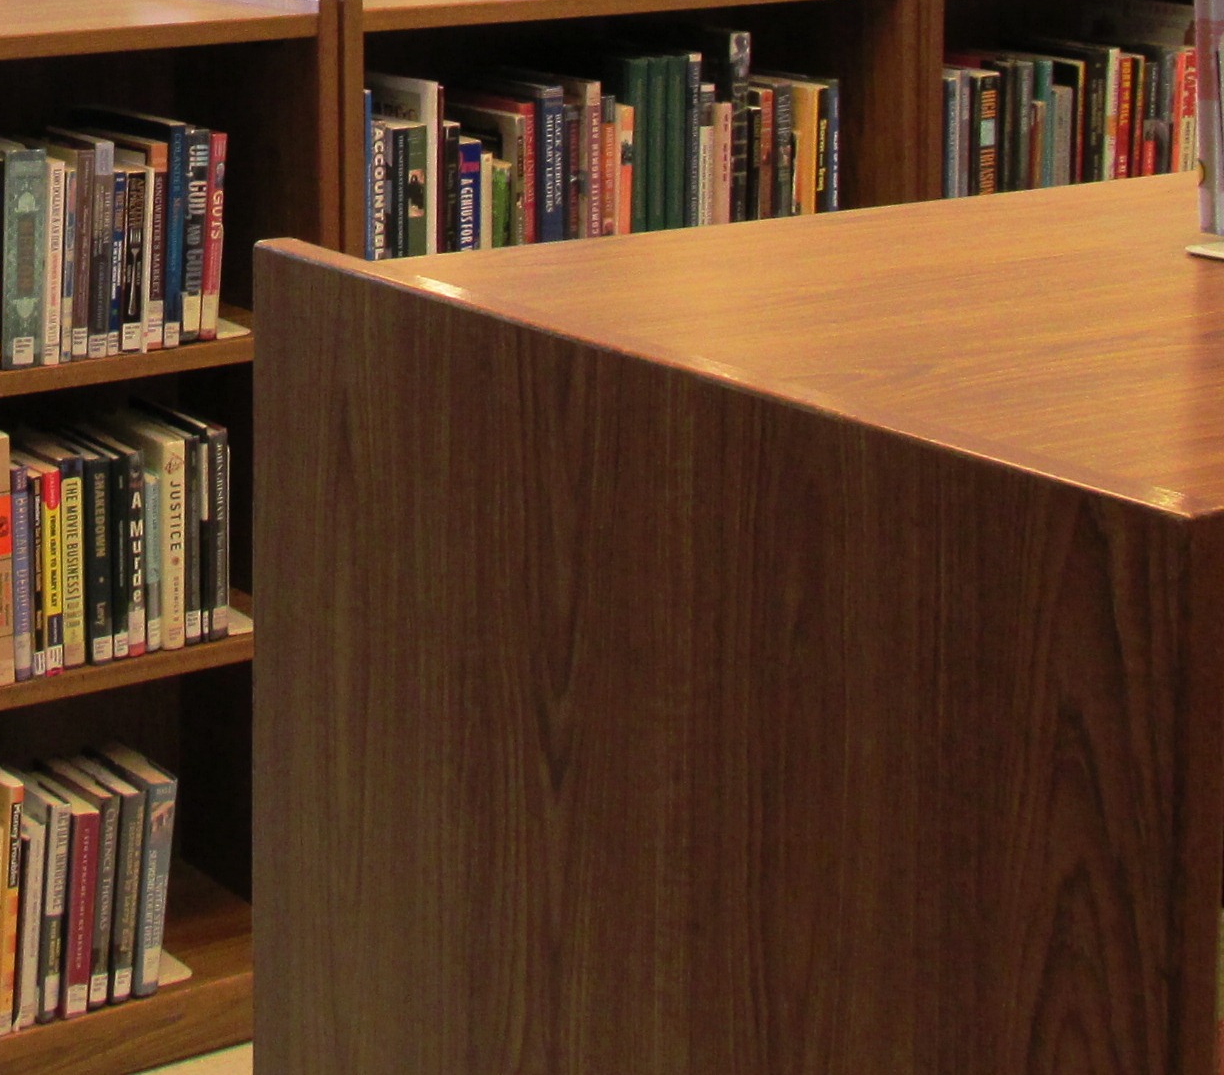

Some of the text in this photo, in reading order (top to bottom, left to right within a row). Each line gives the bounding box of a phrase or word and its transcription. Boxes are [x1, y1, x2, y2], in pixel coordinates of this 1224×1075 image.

[591, 112, 599, 139] ARMY
[981, 90, 997, 119] HIGH
[173, 133, 182, 192] COLANDER
[186, 144, 209, 177] OIL,
[546, 114, 554, 212] MILITARY LEADERS
[591, 146, 599, 179] ROMAN
[154, 177, 163, 251] SONGWRITER'S
[184, 180, 208, 219] GOD,
[211, 189, 224, 240] GUTS
[374, 127, 384, 260] ACCOUNTABL
[461, 187, 473, 222] GENIUS
[187, 224, 202, 245] AND
[461, 224, 473, 244] FOR
[216, 442, 224, 471] JOHN
[94, 473, 106, 557] SHAKEDOWN
[169, 481, 182, 551] JUSTICE
[216, 472, 224, 522] GRISHAM
[50, 558, 57, 568] TO
[66, 482, 79, 594] THE MOVIE BUSINESS
[130, 491, 143, 603] A Murde
[9, 803, 22, 886] Money Troubles
[56, 812, 70, 849] ACTUAL
[99, 808, 115, 931] CLARENCE THOMAS
